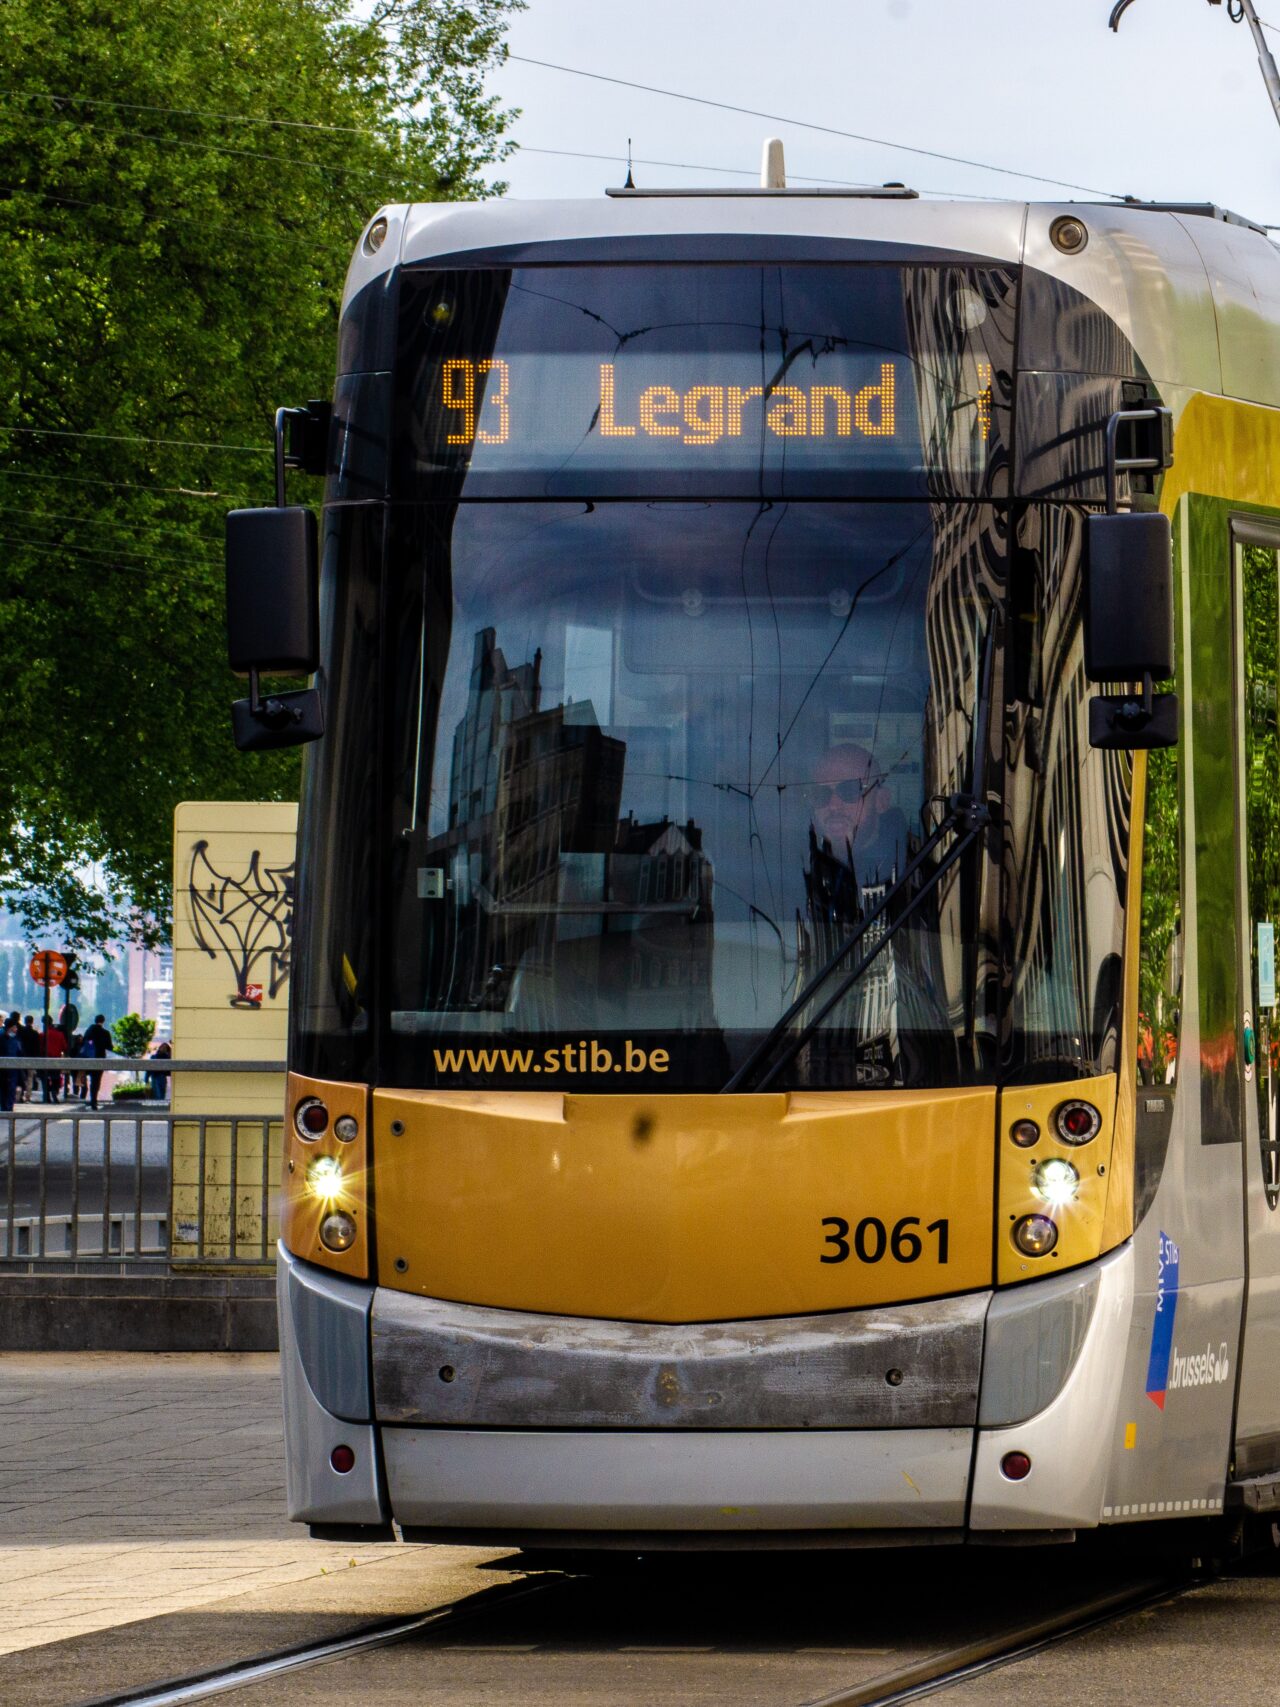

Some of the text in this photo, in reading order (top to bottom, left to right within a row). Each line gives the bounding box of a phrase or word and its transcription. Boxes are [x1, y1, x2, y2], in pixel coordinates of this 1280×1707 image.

[442, 358, 510, 444] 93
[599, 362, 896, 445] Legrand
[433, 1040, 670, 1073] www.stib.be
[819, 1216, 951, 1265] 3061
